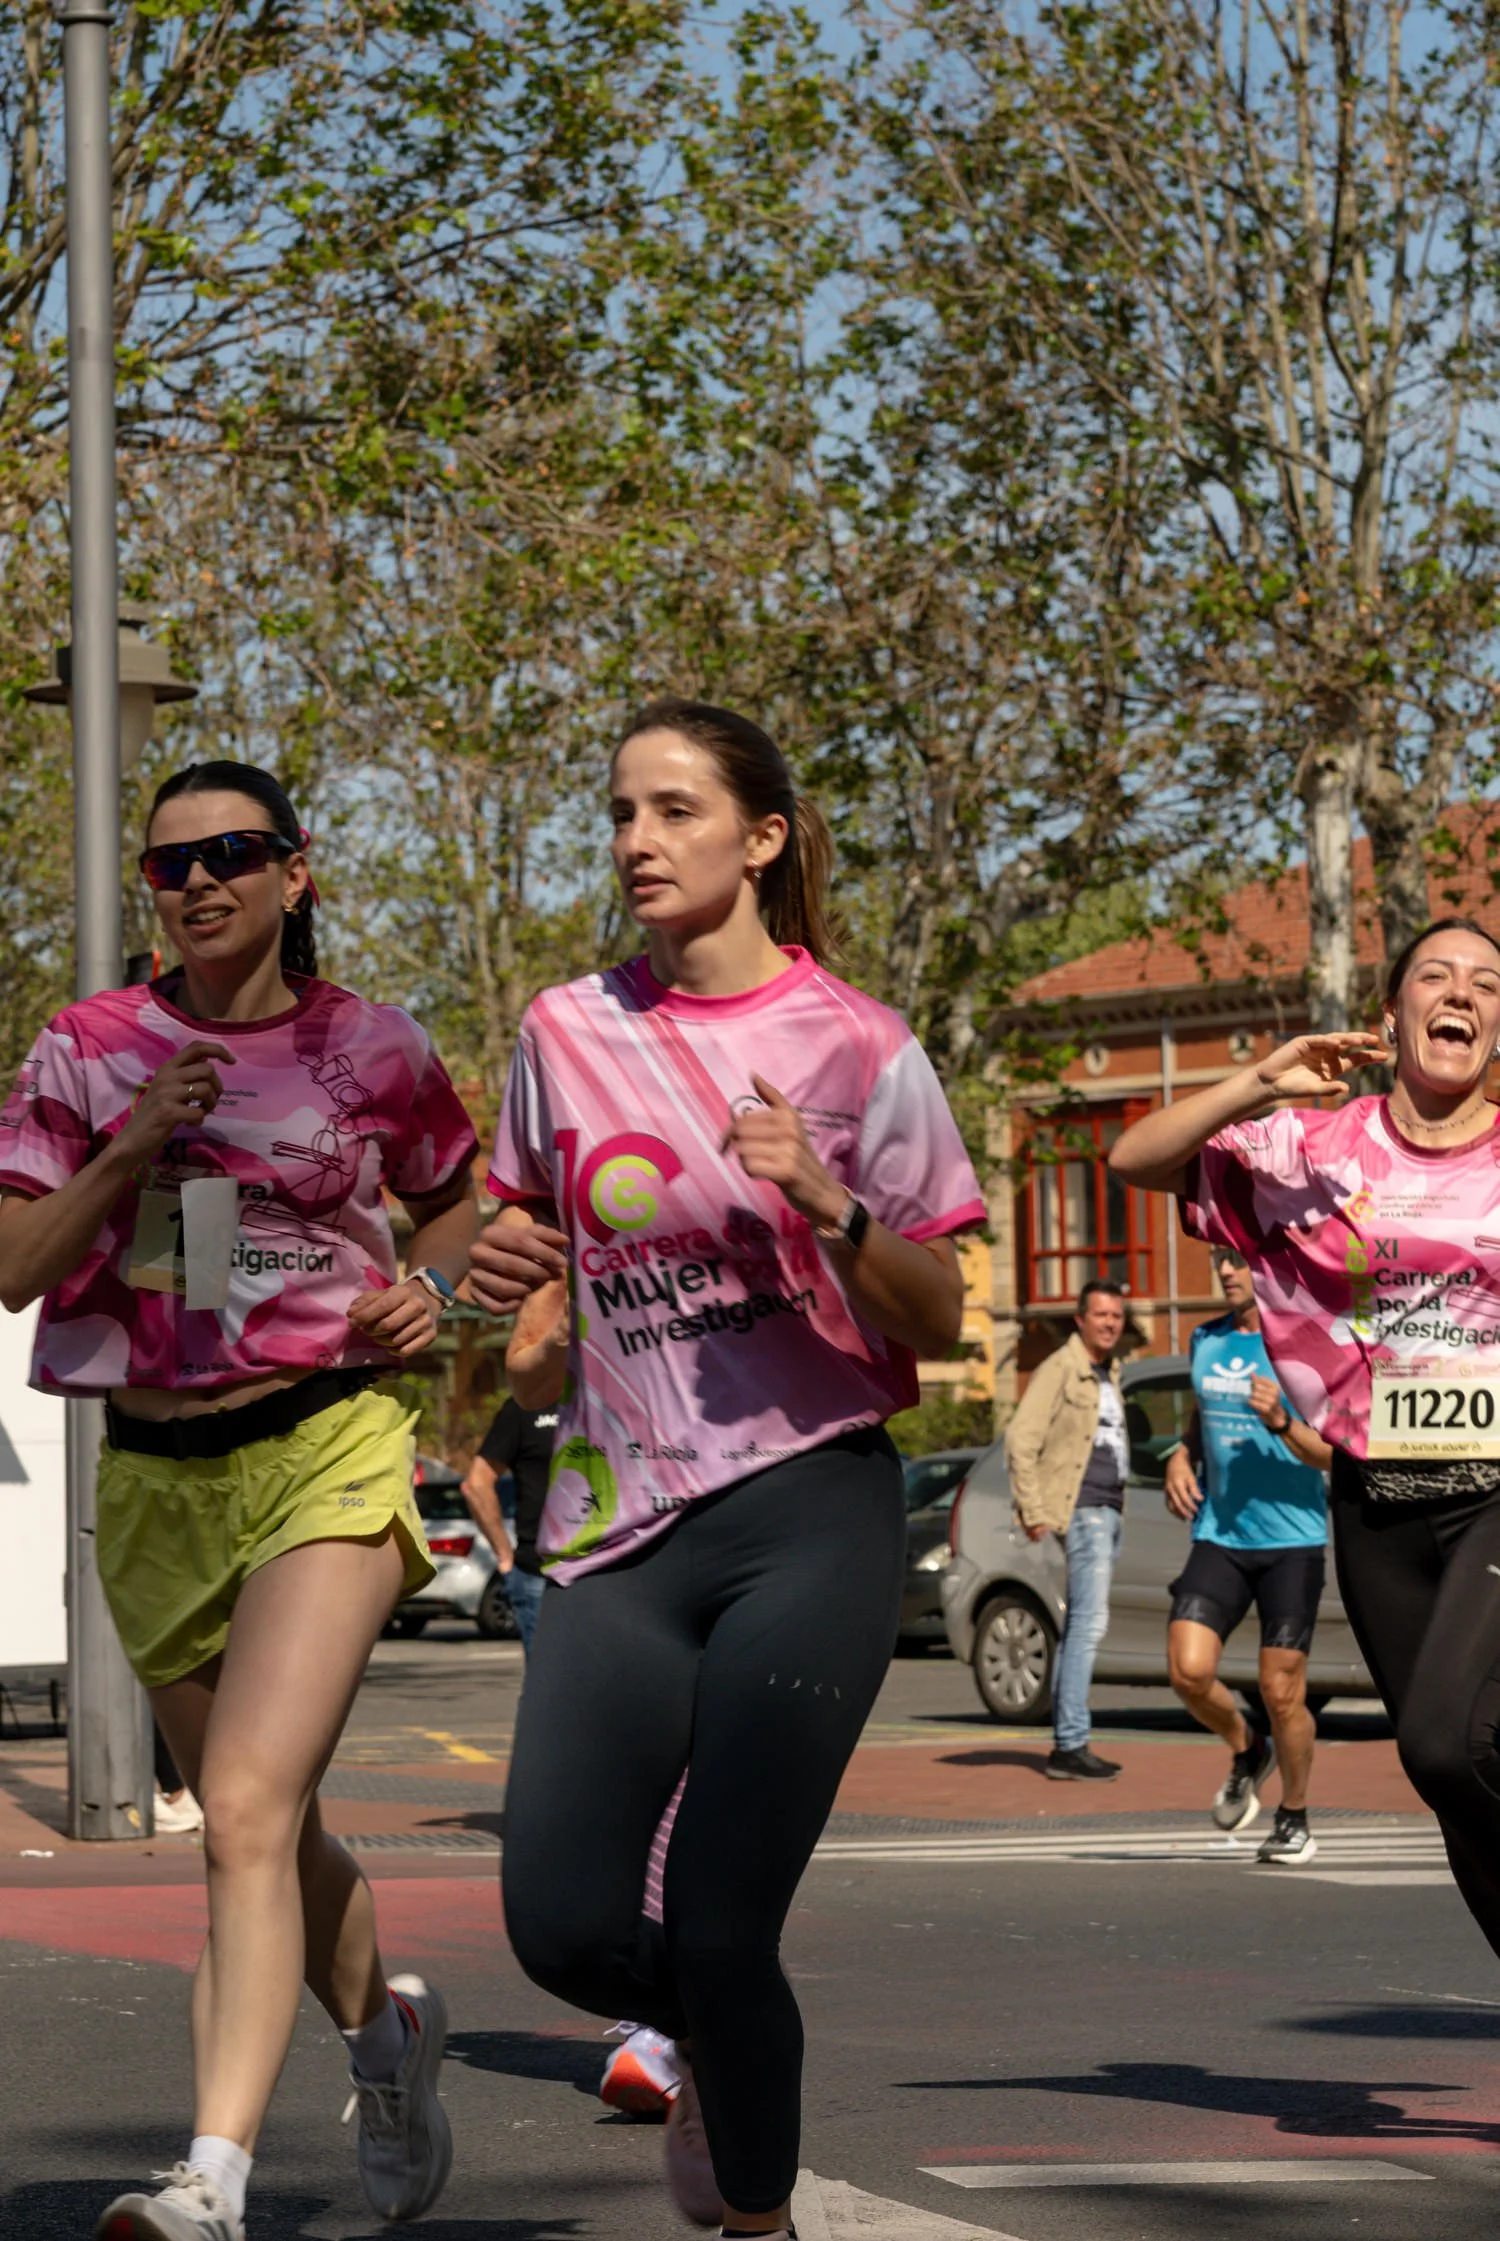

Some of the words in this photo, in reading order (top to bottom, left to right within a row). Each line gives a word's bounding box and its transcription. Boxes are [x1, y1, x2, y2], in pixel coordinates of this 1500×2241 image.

[579, 1225, 720, 1277] Carrera
[1374, 1238, 1398, 1259] XI
[590, 1256, 724, 1318] Mujer
[1374, 1267, 1471, 1287] Carrera
[1384, 1388, 1495, 1430] 11220
